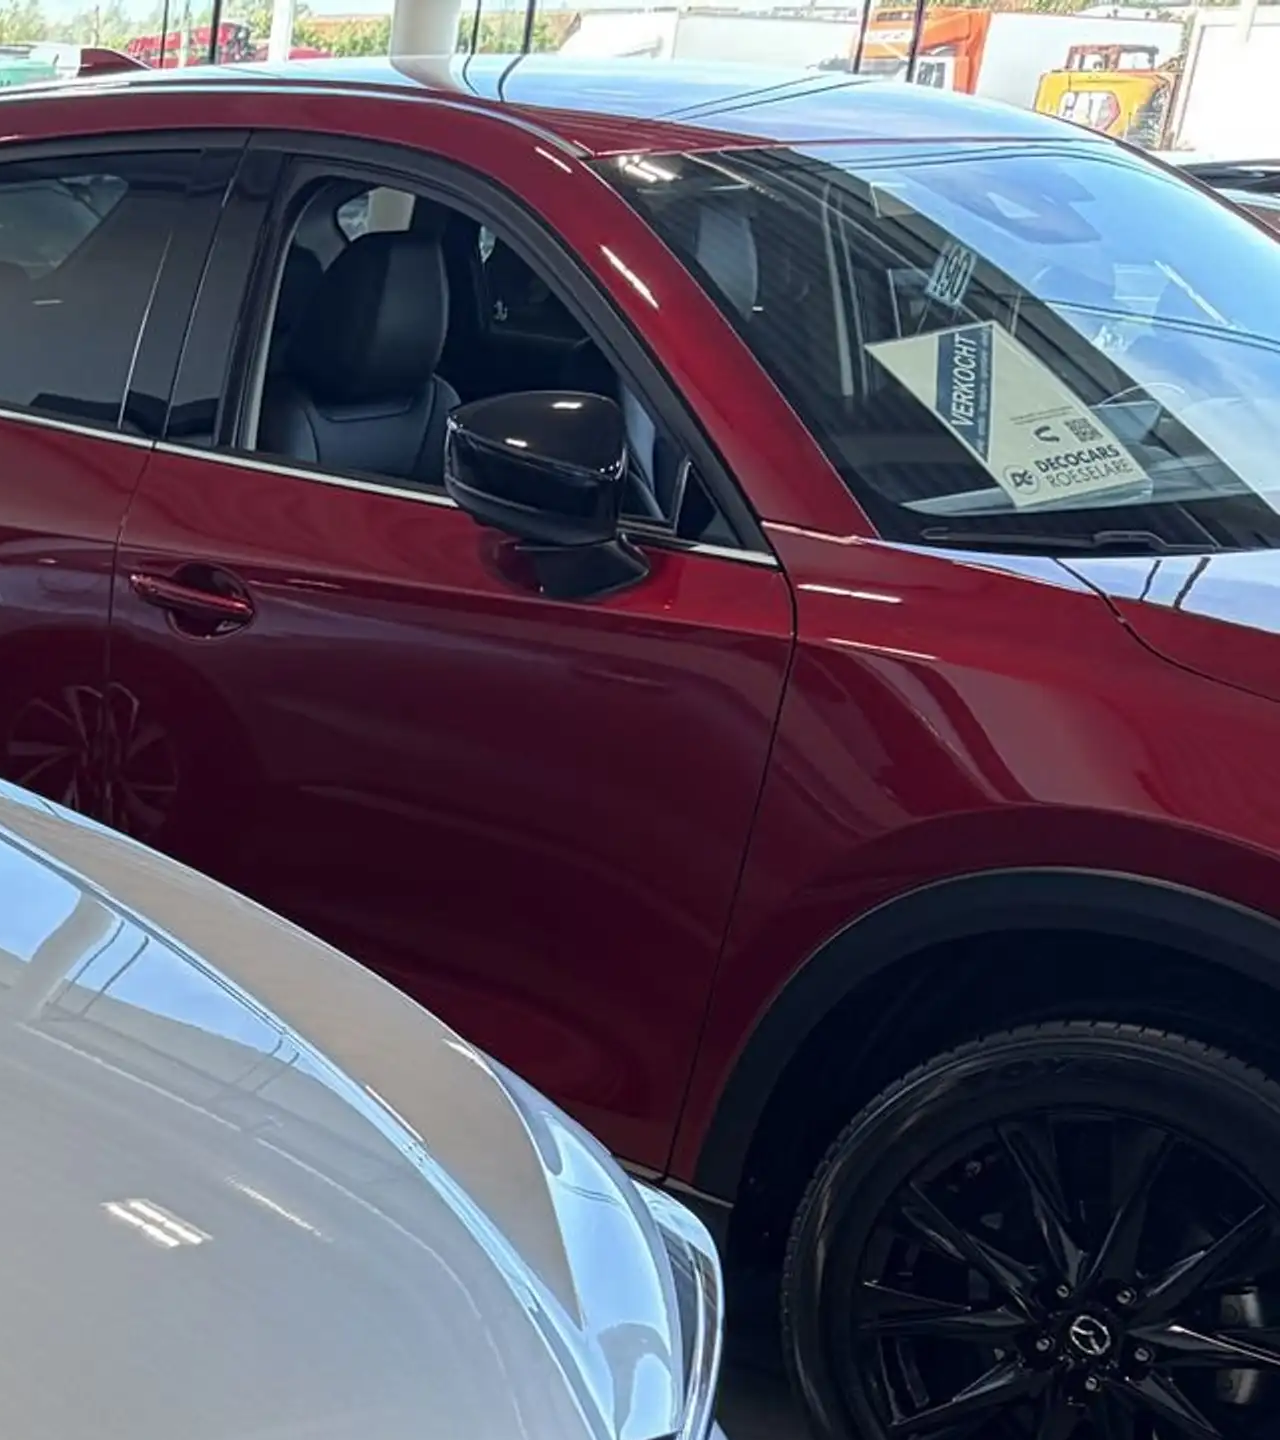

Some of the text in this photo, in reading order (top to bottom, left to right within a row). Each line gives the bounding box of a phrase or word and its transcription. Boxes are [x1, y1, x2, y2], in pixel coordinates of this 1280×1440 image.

[950, 333, 978, 427] VERKOCHT
[1034, 444, 1120, 473] DECOCARS
[1044, 458, 1134, 488] ROESELARE
